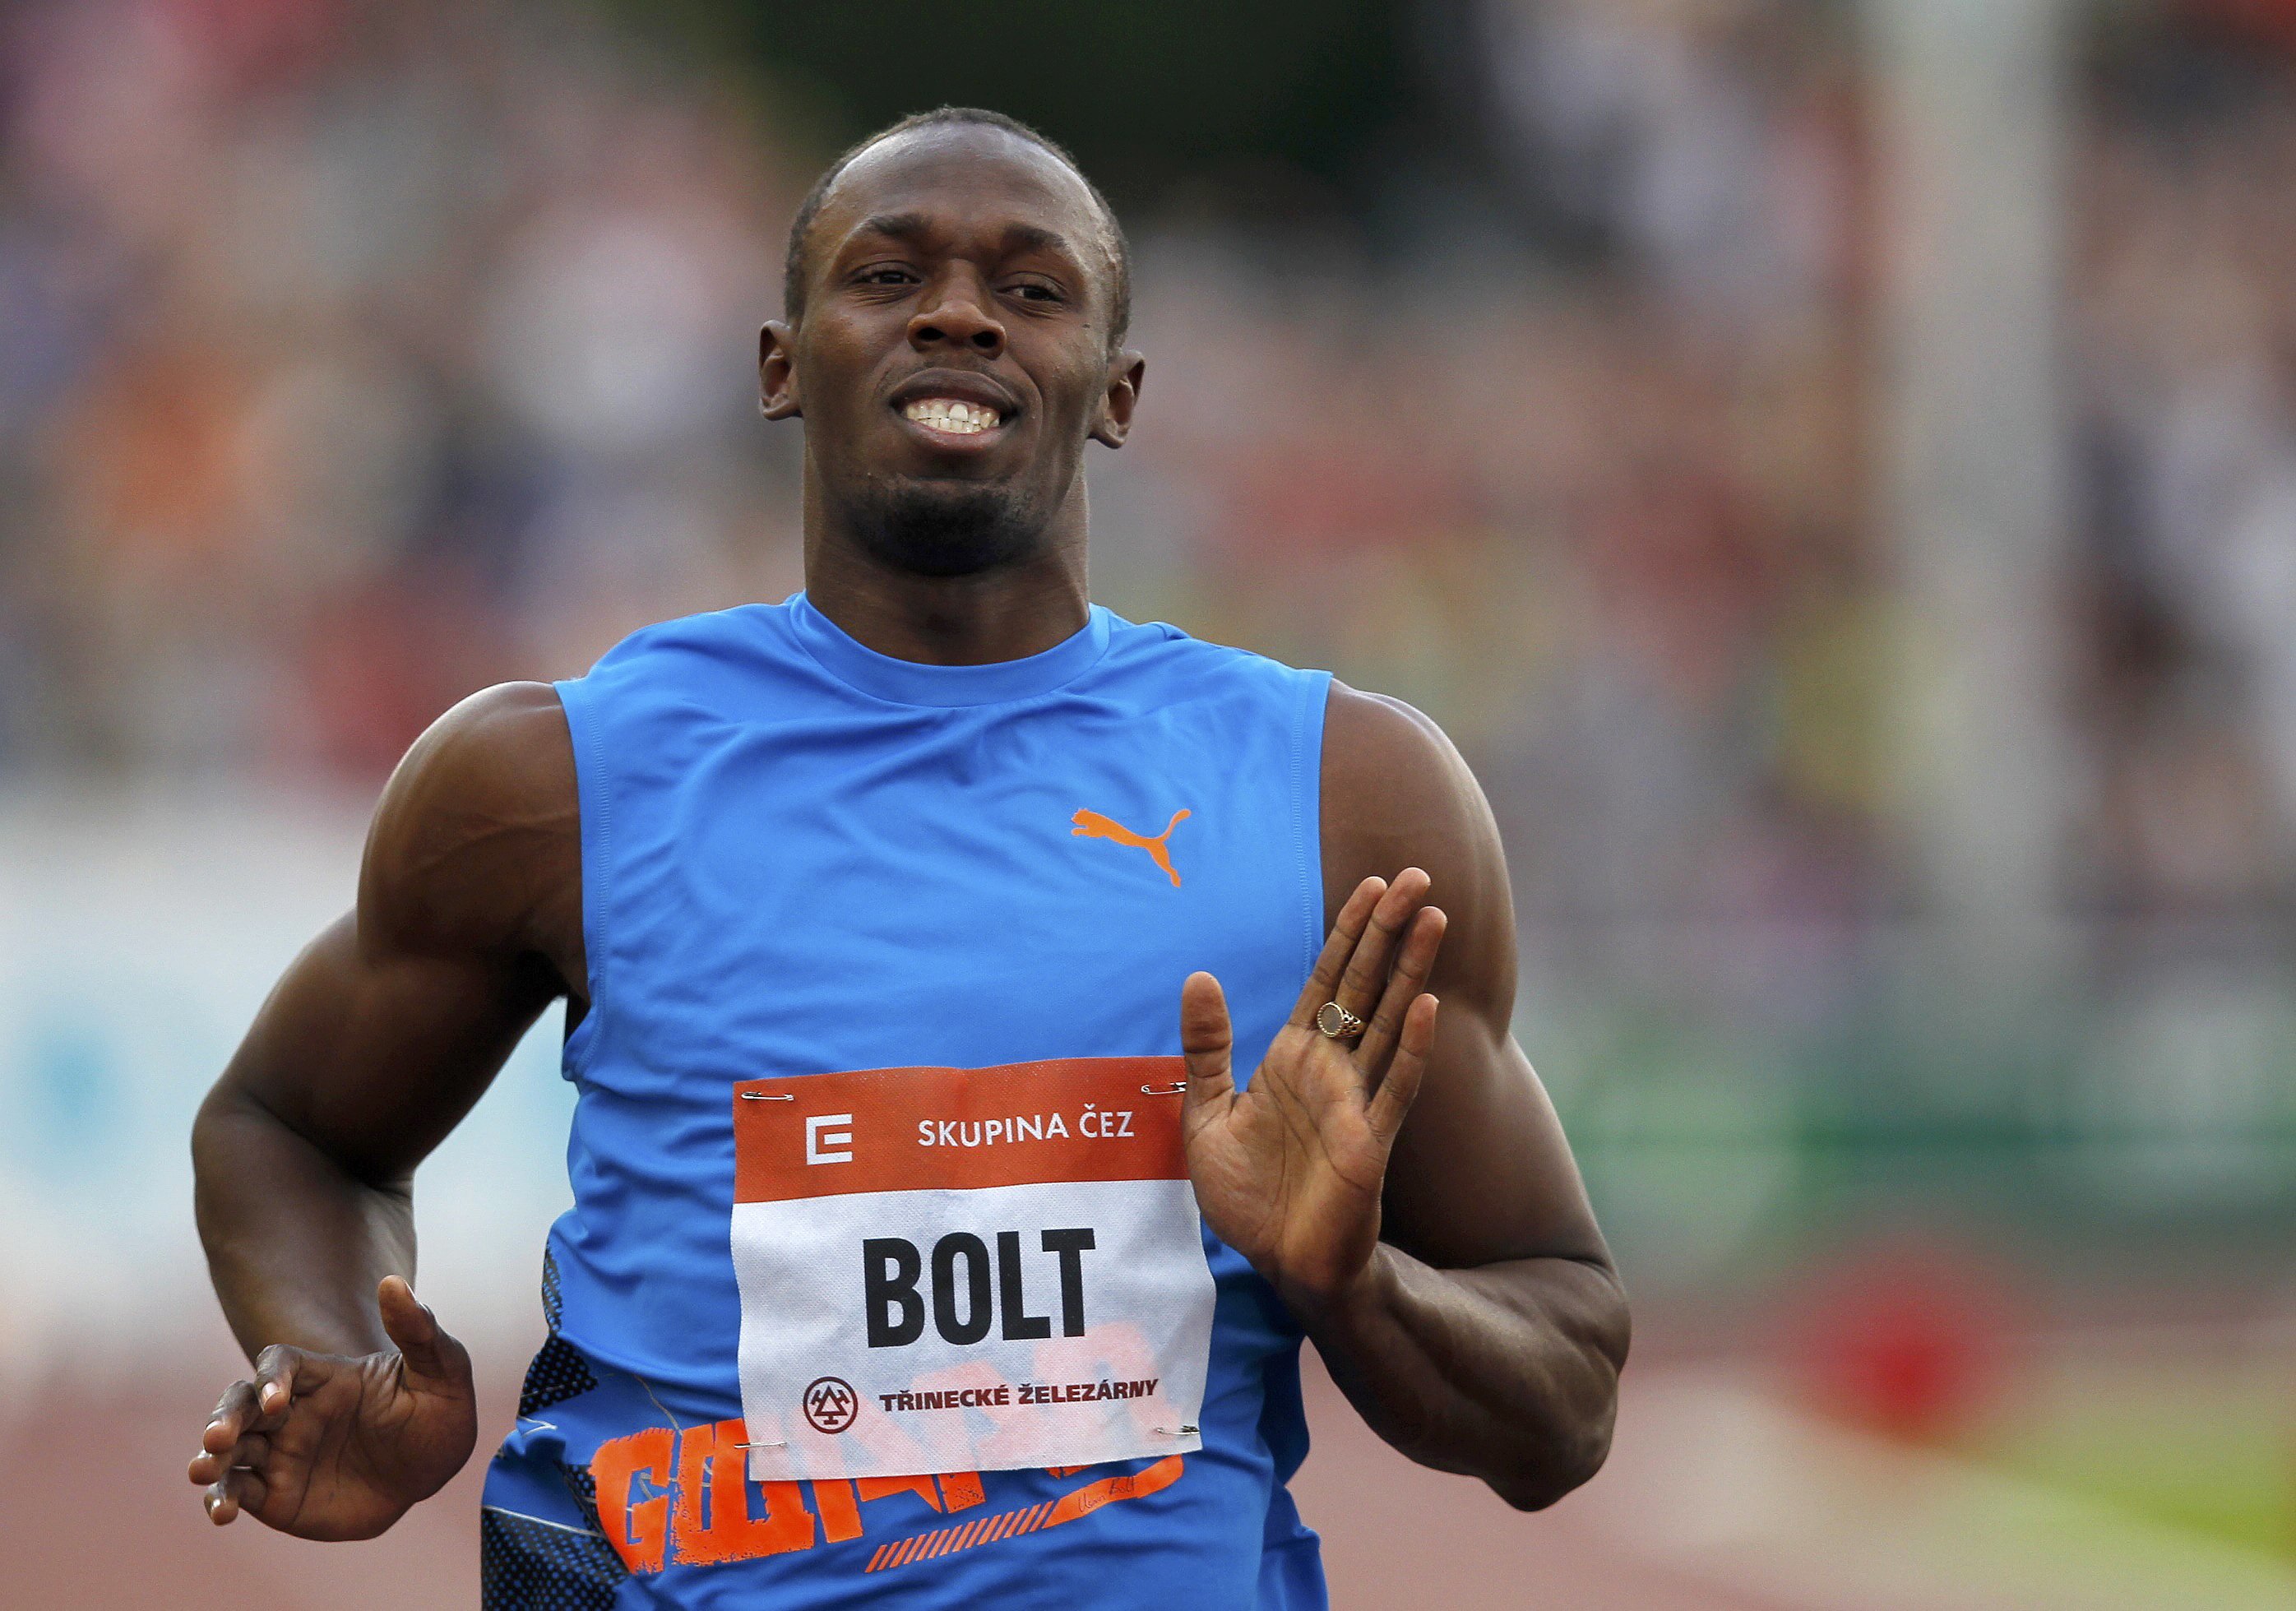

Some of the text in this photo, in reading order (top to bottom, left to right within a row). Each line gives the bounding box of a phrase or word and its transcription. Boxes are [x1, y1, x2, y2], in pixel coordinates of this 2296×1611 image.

[918, 1103, 1135, 1147] SKUPINA ČEZ
[863, 1227, 1096, 1348] BOLT
[878, 1378, 1159, 1412] TŘINECKÉ ŽELEZÁRNY
